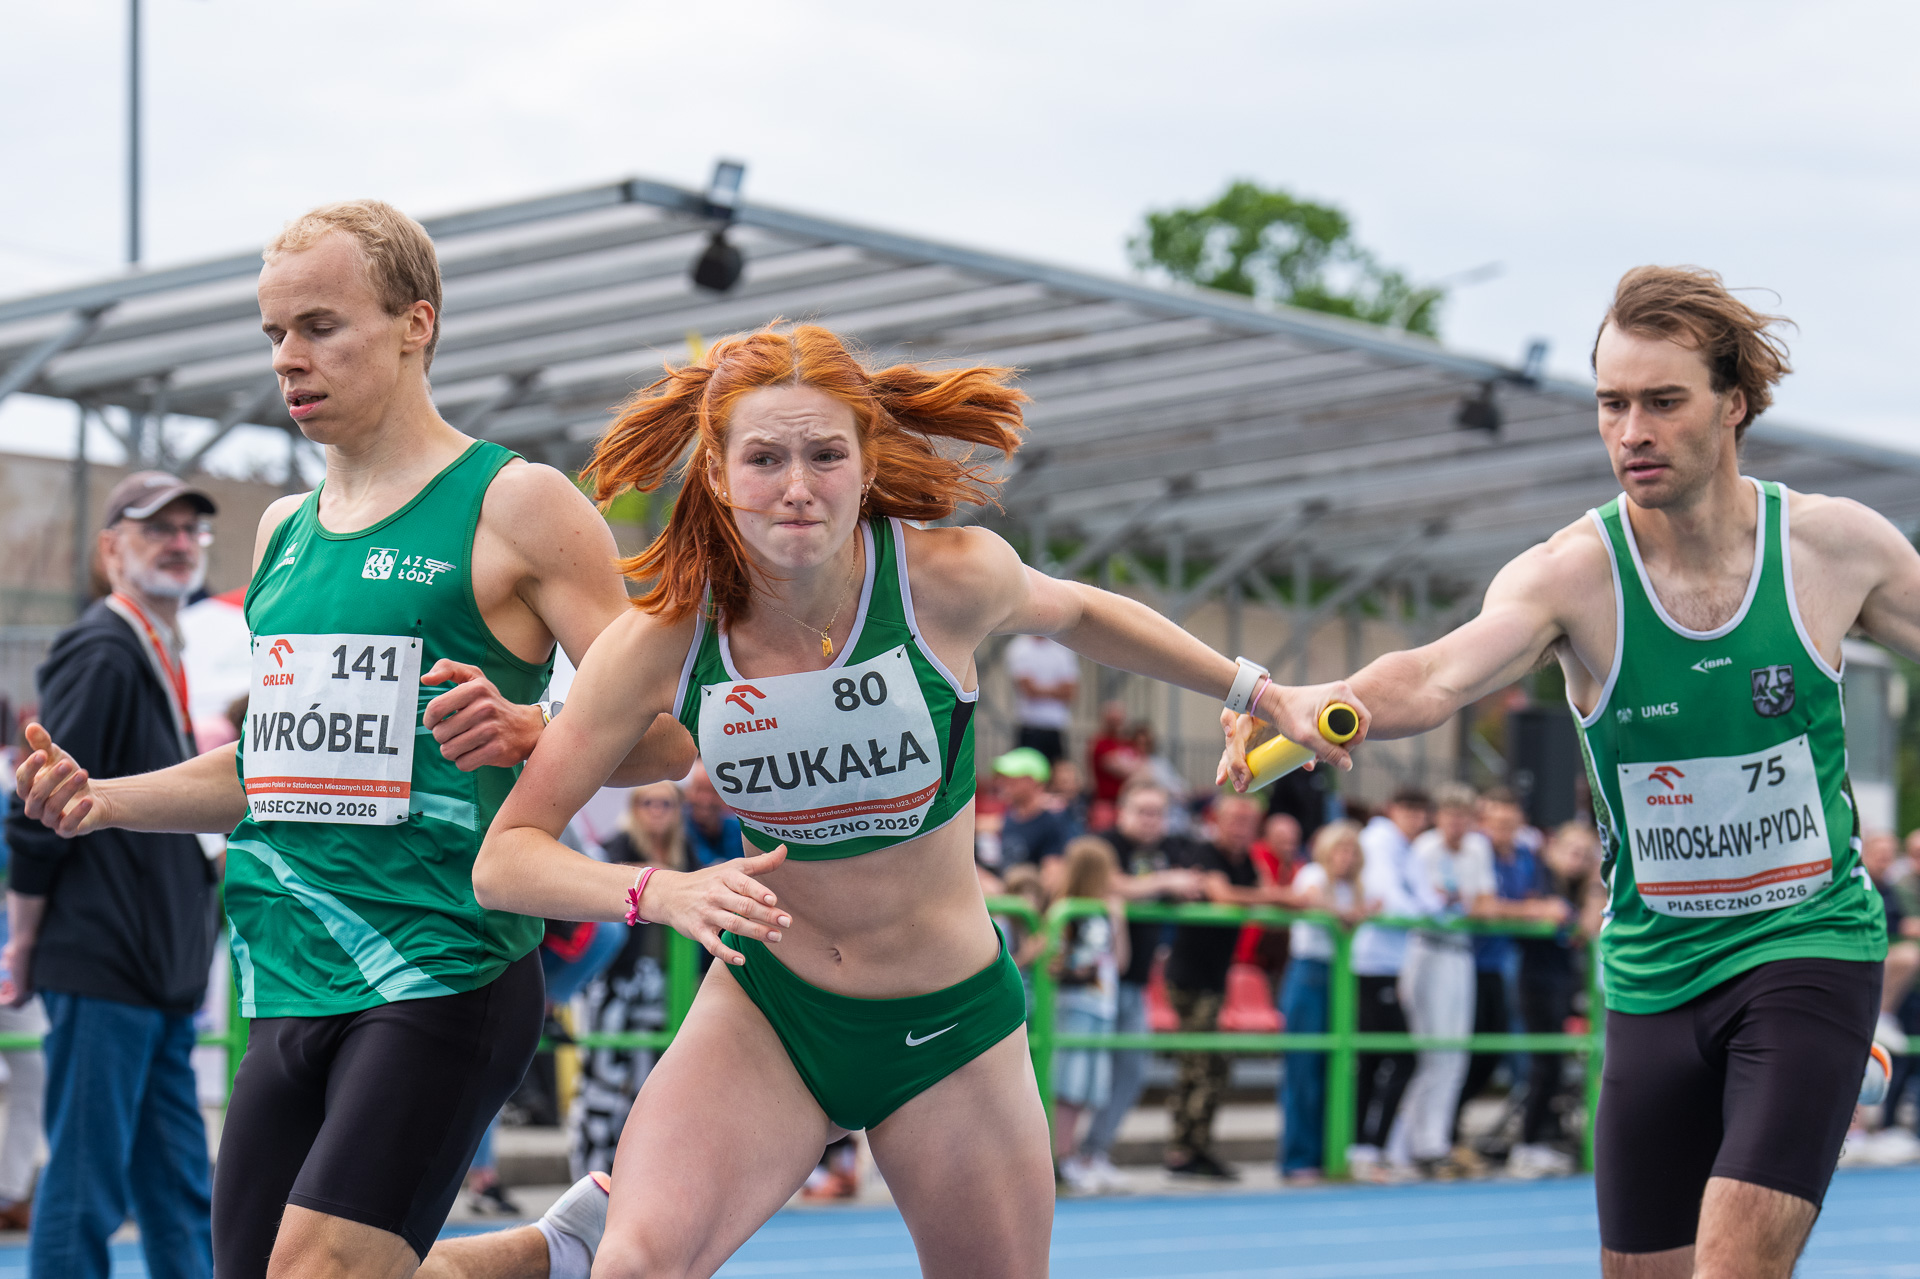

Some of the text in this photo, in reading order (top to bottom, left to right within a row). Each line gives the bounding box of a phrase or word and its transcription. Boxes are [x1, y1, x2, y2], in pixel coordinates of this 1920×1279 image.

[331, 644, 399, 682] 141
[262, 673, 295, 687] ORLEN
[832, 671, 888, 712] 80
[1641, 702, 1679, 718] UMCS
[252, 703, 399, 756] WRÓBEL
[723, 717, 778, 736] ORLEN
[715, 730, 931, 795] SZUKAŁA
[1741, 755, 1786, 794] 75
[254, 800, 377, 818] PIASECZNO 2026
[788, 813, 809, 821] Polski
[854, 803, 896, 813] Mieszanych
[1646, 794, 1693, 806] ORLEN
[763, 814, 920, 840] PIASECZNO 2026
[1635, 804, 1819, 862] MIROSŁAW-PYDA
[1667, 884, 1807, 913] PIASECZNO 2026
